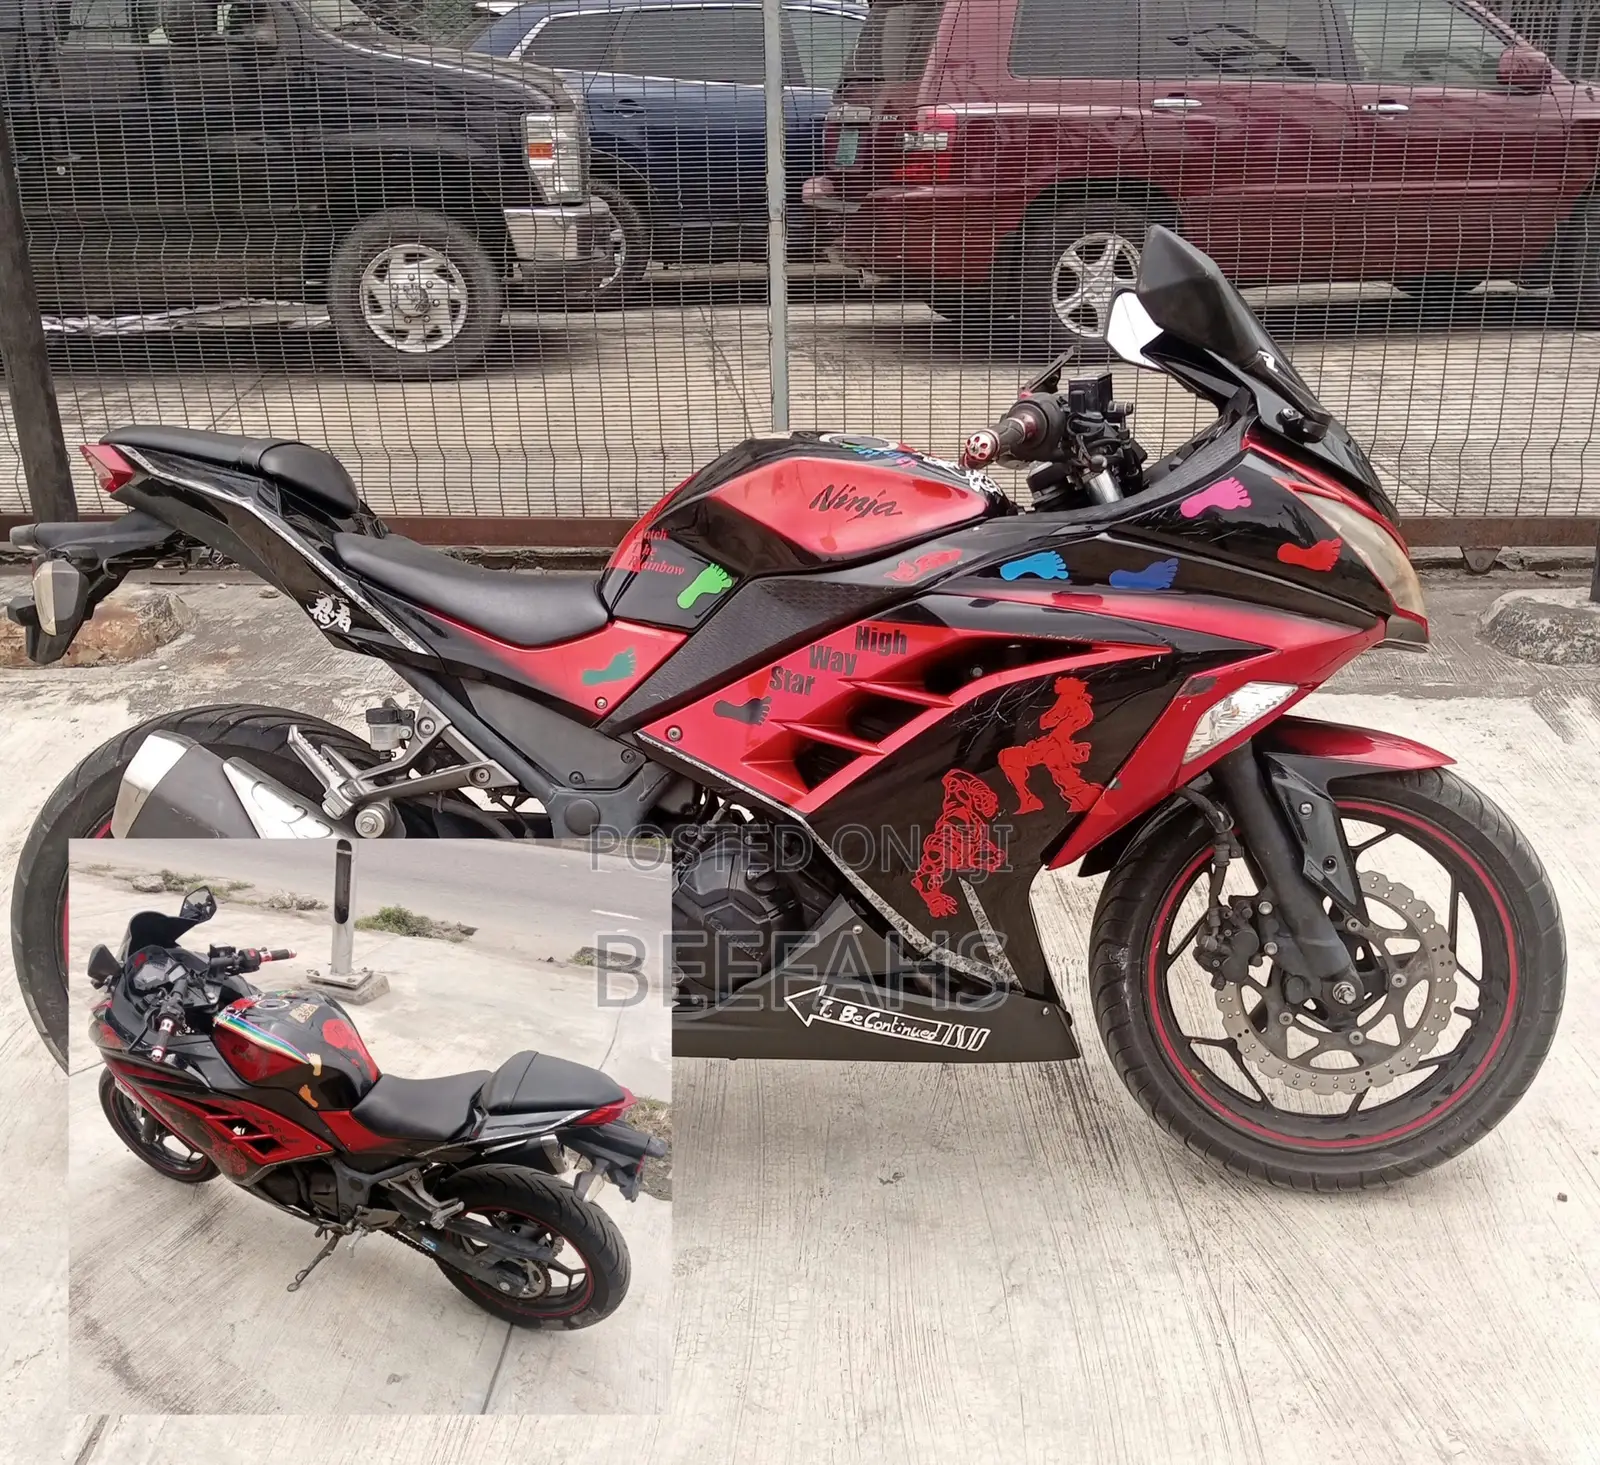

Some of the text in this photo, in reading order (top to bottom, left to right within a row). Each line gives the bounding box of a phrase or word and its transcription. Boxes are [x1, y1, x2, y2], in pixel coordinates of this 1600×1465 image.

[809, 484, 902, 522] Ninja
[628, 554, 685, 575] Rainbow
[855, 625, 907, 656] High
[808, 645, 857, 676] Way
[769, 665, 816, 695] Star
